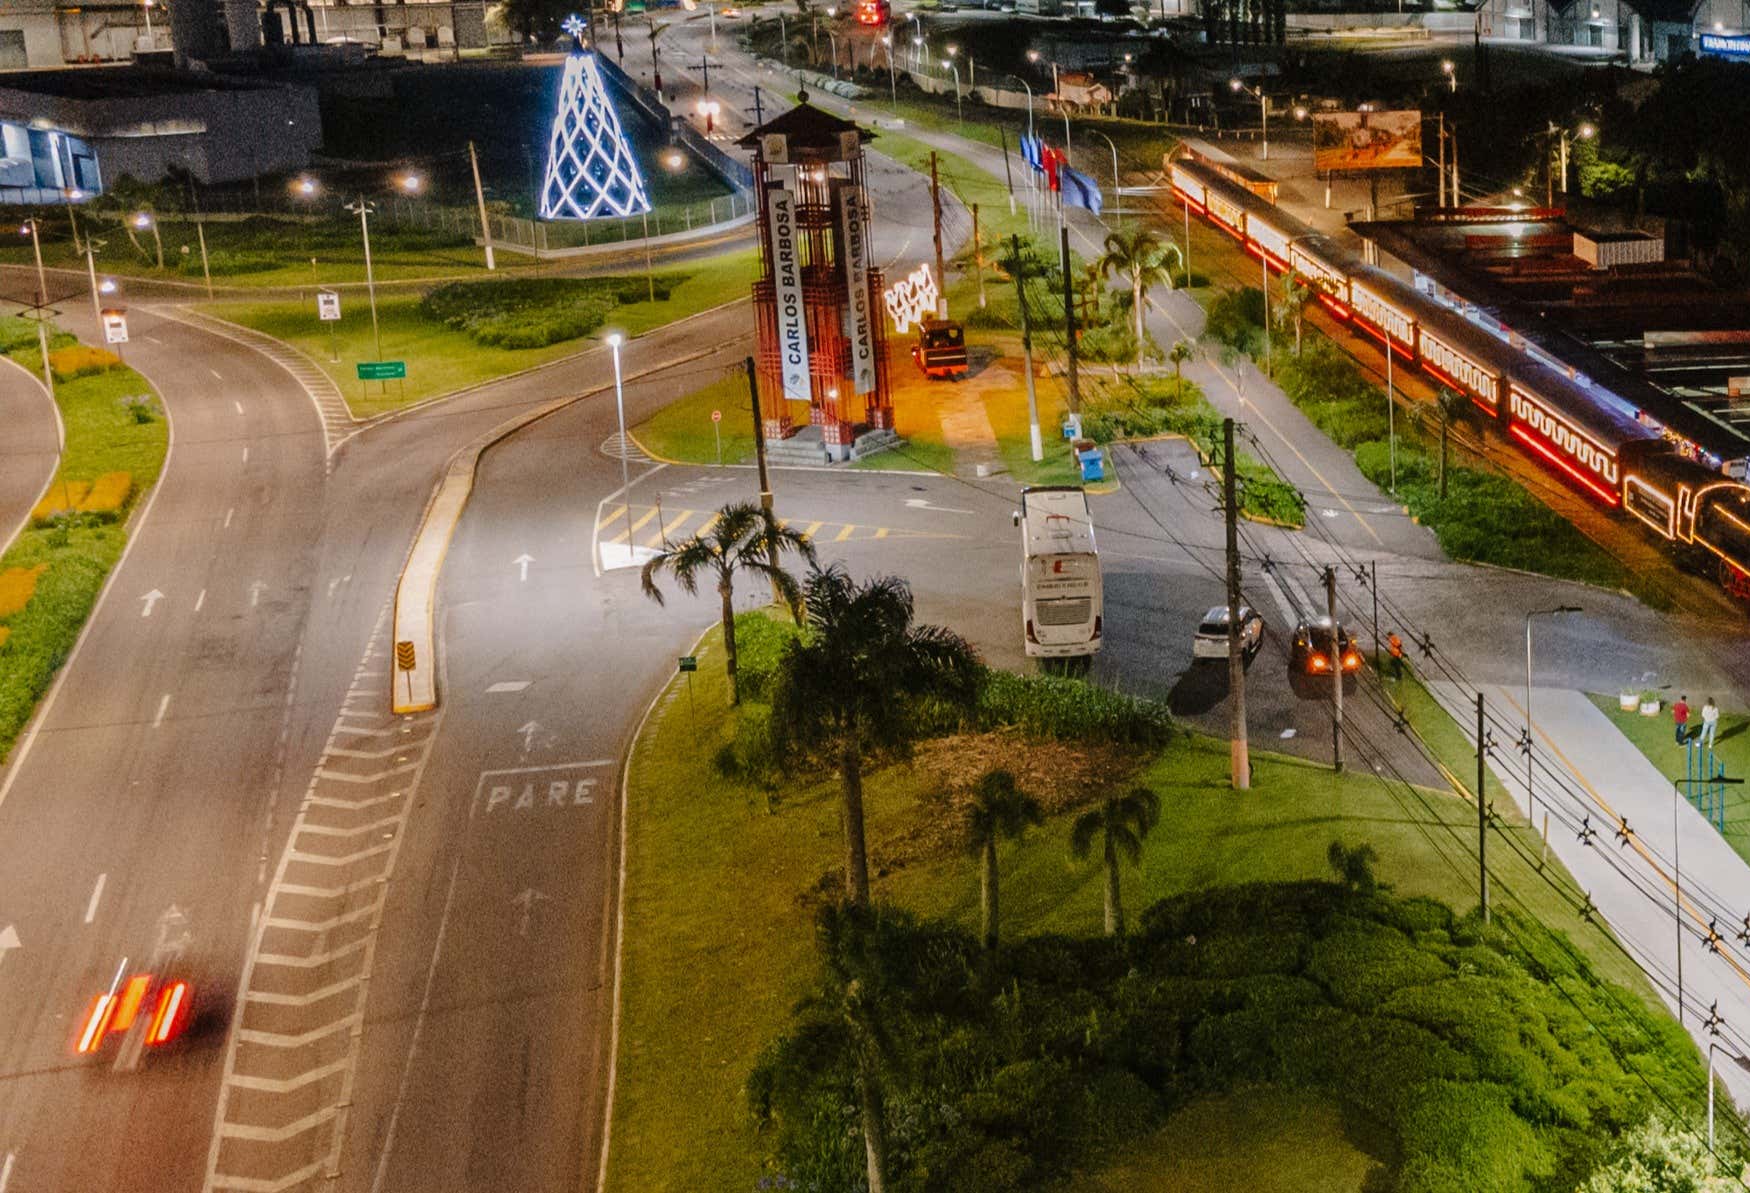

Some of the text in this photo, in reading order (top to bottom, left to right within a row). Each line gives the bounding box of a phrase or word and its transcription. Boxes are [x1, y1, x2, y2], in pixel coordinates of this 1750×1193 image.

[775, 200, 802, 366] CARLOS BARBOSA
[847, 196, 869, 360] CARLOS BARBOSA
[486, 778, 597, 813] PARE
